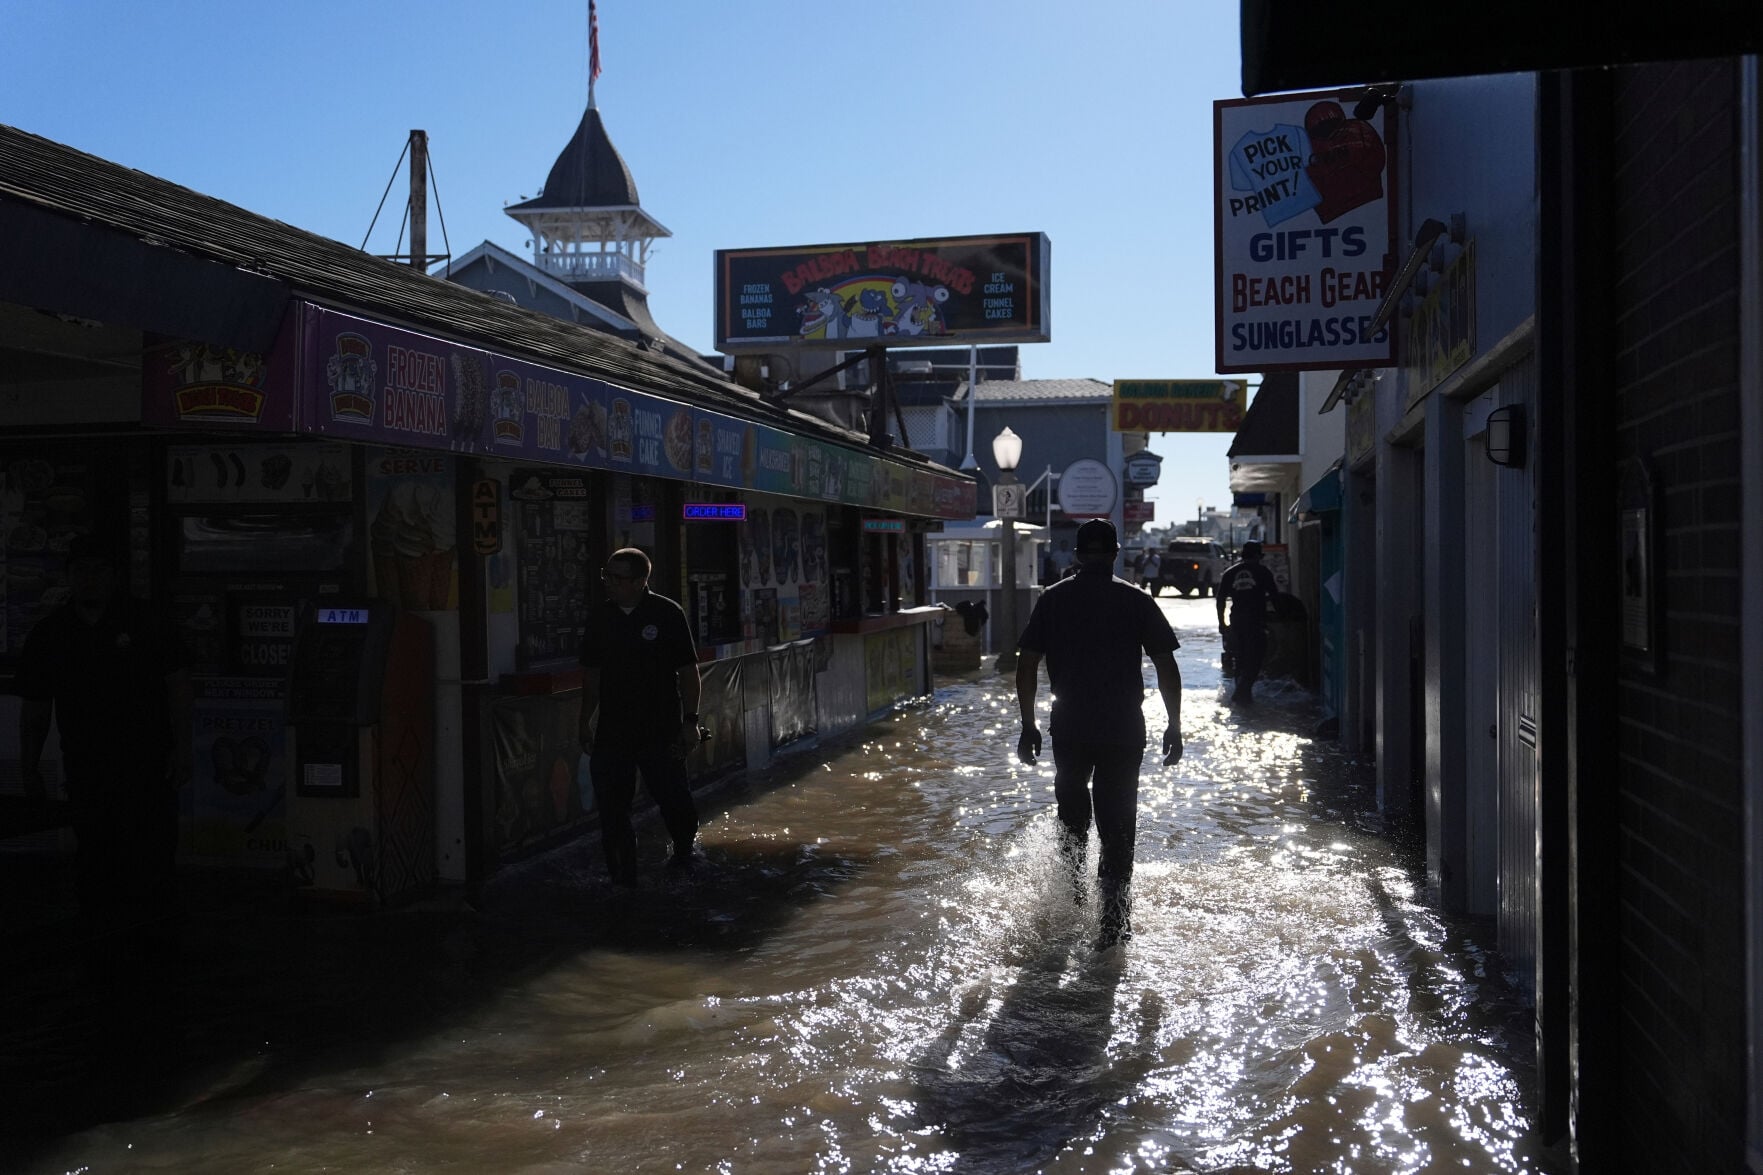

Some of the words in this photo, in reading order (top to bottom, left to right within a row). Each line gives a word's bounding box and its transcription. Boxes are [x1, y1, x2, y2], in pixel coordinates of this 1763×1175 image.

[1244, 134, 1293, 164] PICK
[1252, 155, 1302, 181] YOUR
[1229, 171, 1299, 217] PRINT!
[1250, 226, 1367, 263] GIFTS
[867, 244, 920, 272] BEACH
[743, 283, 770, 294] FROZEN
[984, 283, 1014, 294] CREAM
[991, 272, 1006, 283] ICE
[740, 294, 773, 305] BANANAS
[1232, 273, 1311, 313] BEACH
[1320, 267, 1389, 309] GEAR
[742, 308, 772, 319] BALBOA
[983, 297, 1014, 309] FUNNEL
[746, 319, 767, 329] BARS
[985, 309, 1012, 320] CAKES
[387, 344, 446, 396] FROZEN
[526, 377, 570, 421] BALBOA
[383, 386, 447, 436] BANANA
[1118, 401, 1241, 430] DONUTS
[537, 414, 561, 451] BAR
[635, 408, 663, 440] FUNNEL
[639, 438, 659, 466] CAKE
[379, 457, 446, 474] SERVE
[475, 482, 498, 537] ATM
[686, 506, 718, 517] ORDER
[720, 506, 743, 518] HERE
[246, 607, 290, 619] SORRY
[327, 610, 360, 623] ATM
[248, 621, 289, 632] WE'RE
[241, 643, 291, 665] CLOSE
[202, 717, 275, 731] PRETZEL
